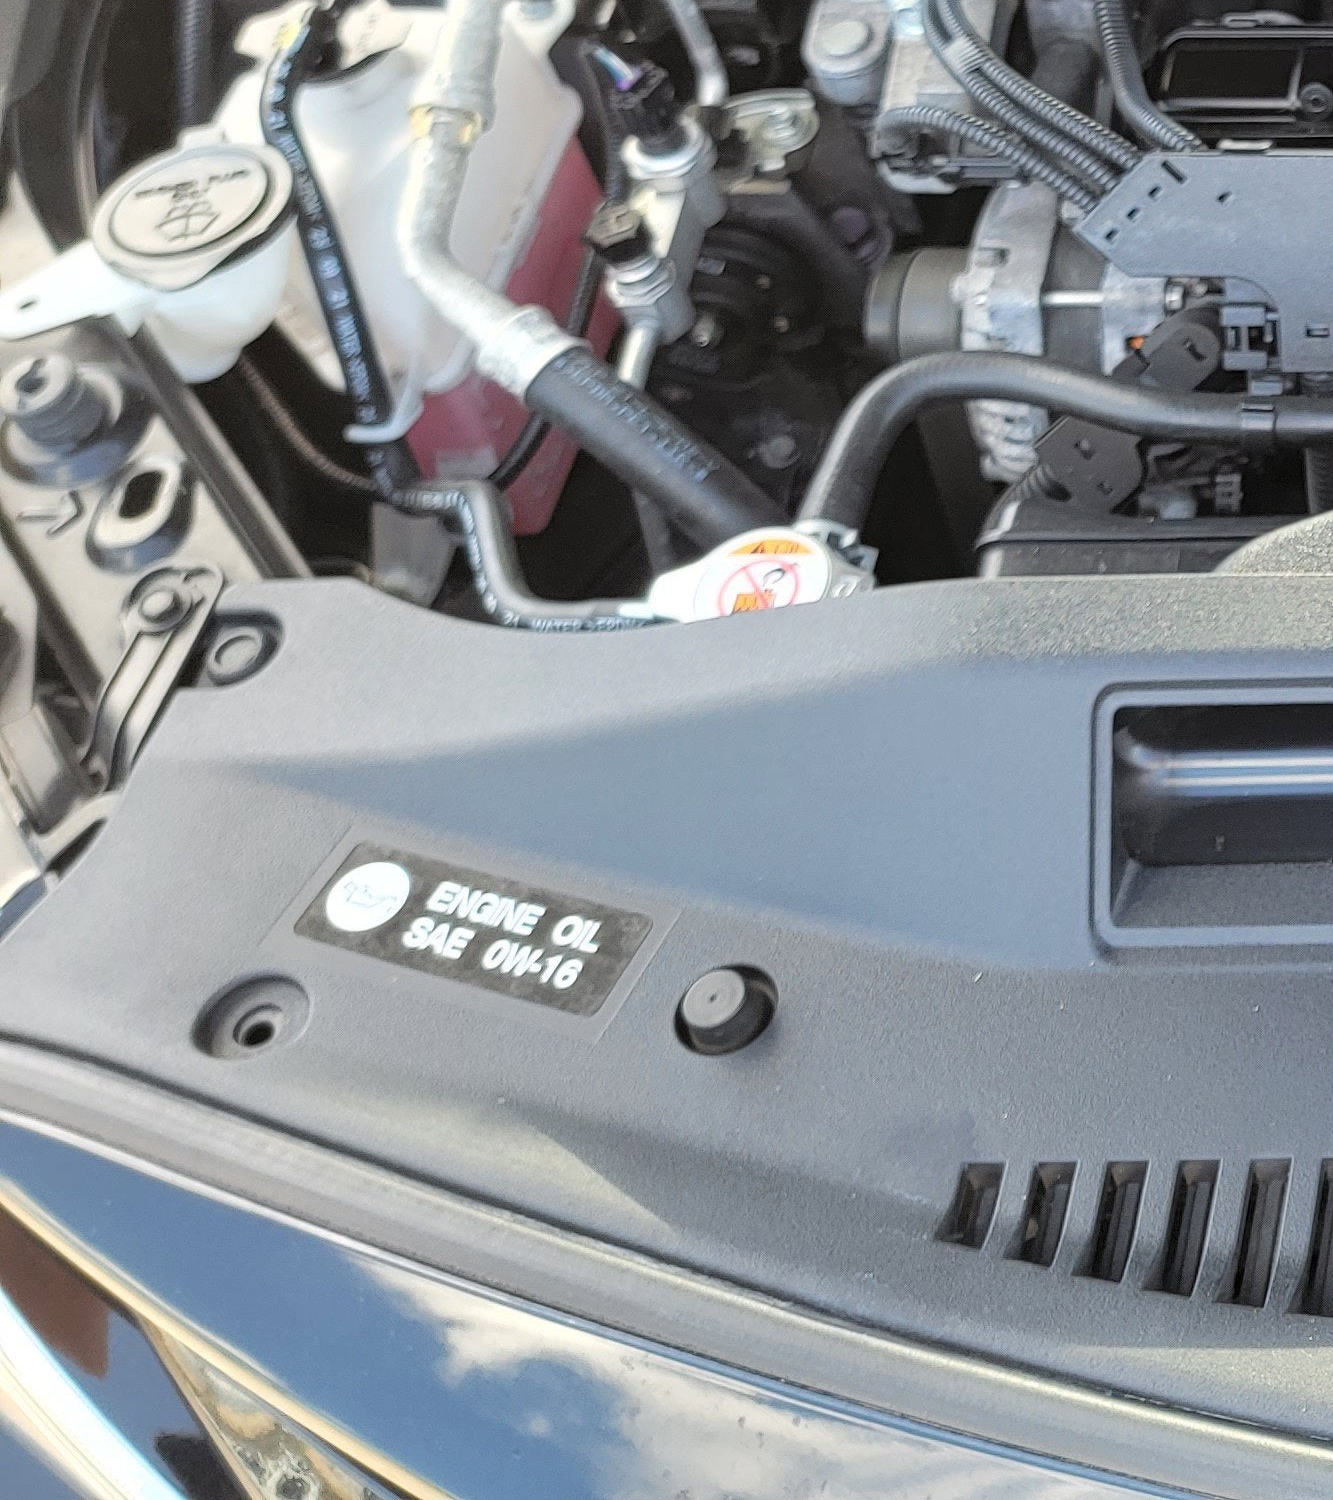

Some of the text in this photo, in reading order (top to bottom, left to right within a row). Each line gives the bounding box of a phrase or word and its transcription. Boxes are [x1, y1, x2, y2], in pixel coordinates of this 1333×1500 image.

[402, 916, 584, 990] SAE 0W-16
[426, 881, 602, 953] ENGINE OIL
